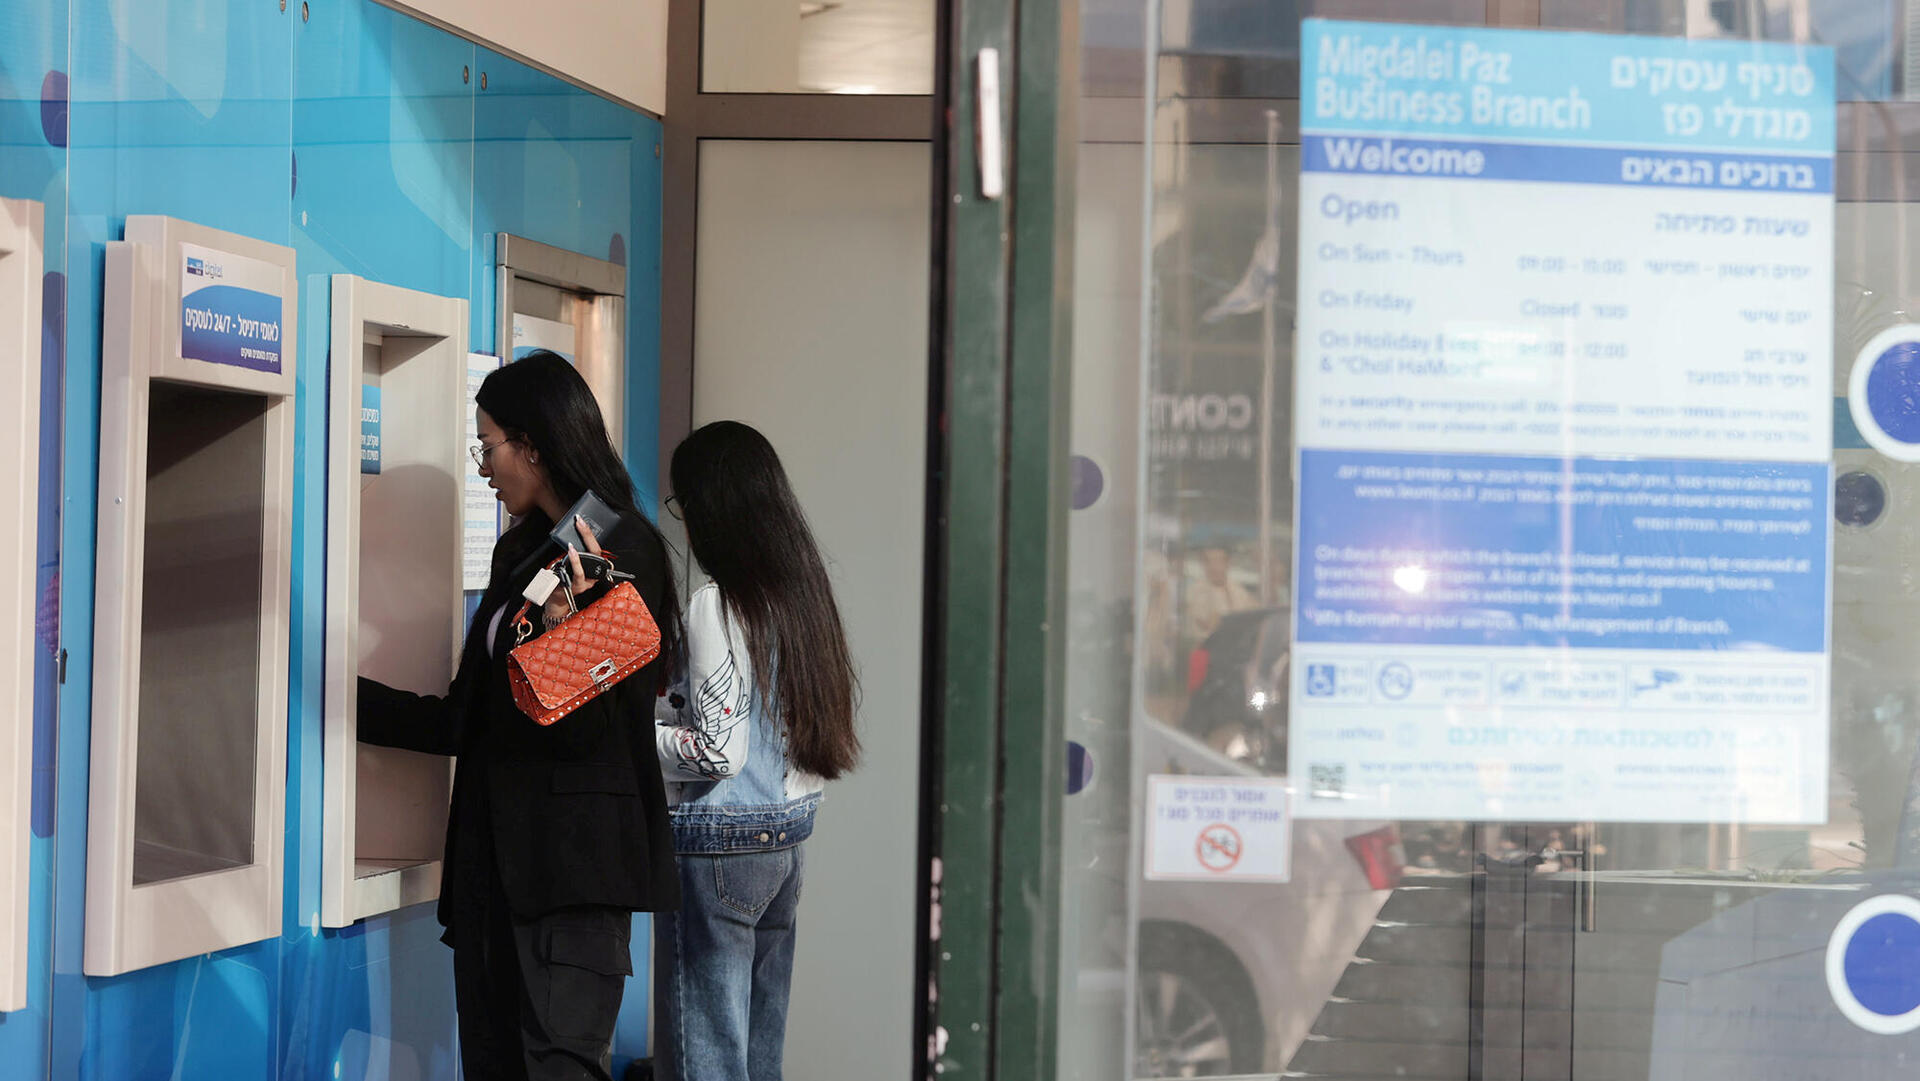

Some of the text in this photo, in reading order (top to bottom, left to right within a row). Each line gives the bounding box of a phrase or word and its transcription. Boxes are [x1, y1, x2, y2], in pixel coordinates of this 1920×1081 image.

[1317, 35, 1512, 84] Migdalei Paz
[1611, 57, 1814, 99] סניף עסקים
[1316, 77, 1591, 129] Business Branch
[1662, 98, 1811, 141] מגדלי פז
[1324, 137, 1485, 175] Welcome
[1621, 156, 1815, 188] ברוכים הבאים
[1320, 193, 1399, 225] Open
[1655, 213, 1809, 236] שעות פתיחה
[1318, 243, 1348, 261] On
[1353, 243, 1391, 263] Sun
[1411, 246, 1465, 267] Thurs
[1318, 290, 1415, 315] On Friday
[185, 308, 213, 332] לעסקים
[215, 313, 231, 334] 24/7
[238, 314, 259, 339] דיגיטל
[261, 321, 279, 342] לאומי
[1318, 331, 1349, 350] On
[1354, 332, 1432, 356] Holiday
[1319, 356, 1333, 373] &
[1315, 546, 1338, 560] On
